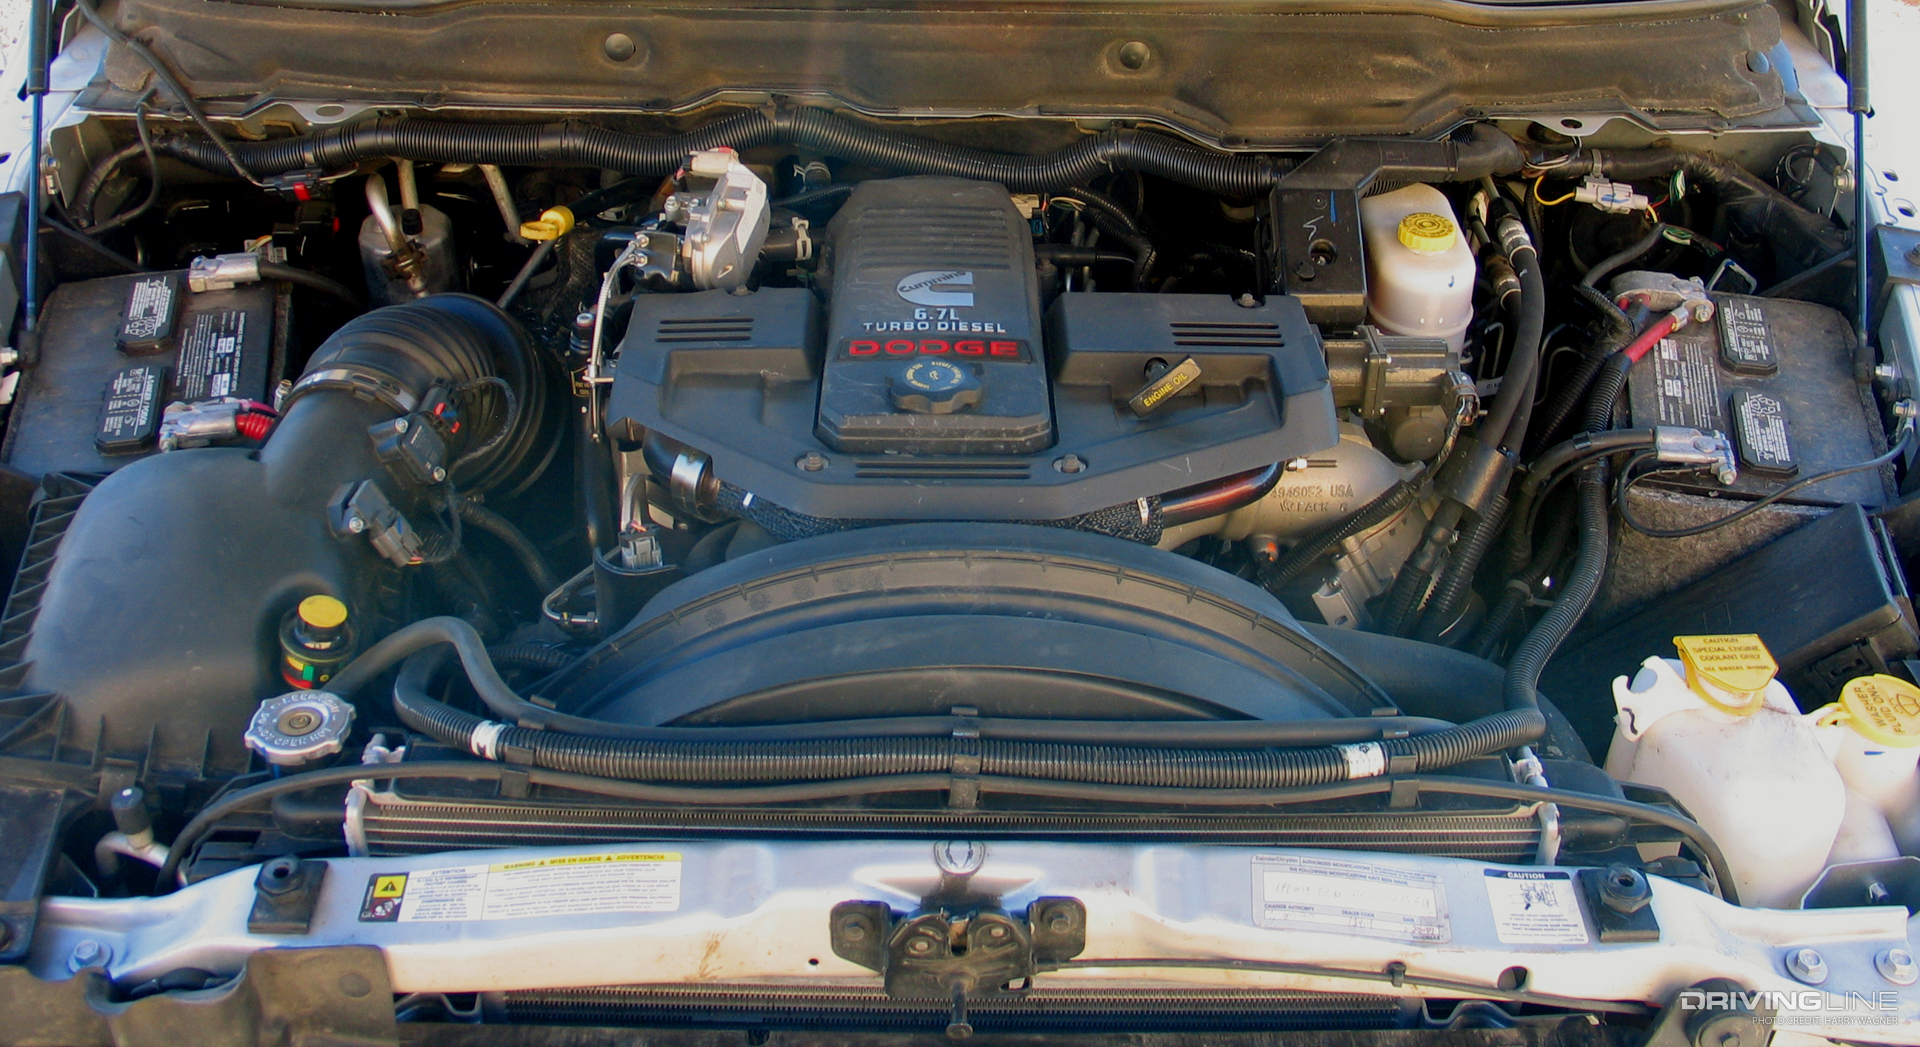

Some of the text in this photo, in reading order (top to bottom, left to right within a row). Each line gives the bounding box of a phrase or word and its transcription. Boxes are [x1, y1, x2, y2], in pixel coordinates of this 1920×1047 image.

[914, 308, 959, 321] 6.7L
[862, 321, 1007, 334] TURBO DIESEL
[849, 339, 1019, 356] DODGE
[1142, 372, 1189, 408] ENGINE OIL
[1330, 484, 1355, 498] USA
[1702, 637, 1739, 645] CAUTION
[1699, 654, 1739, 662] COOLANT
[1853, 686, 1888, 728] WASHER
[1860, 679, 1907, 734] FLUID ONLY
[503, 861, 536, 869] WARNING
[549, 857, 567, 865] MISE
[578, 856, 602, 864] GARDE
[1255, 855, 1299, 864] DaimlerChrysler
[1302, 859, 1371, 871] AUTHORIZED MODIFICATIONS
[1507, 871, 1546, 880] CAUTION
[1287, 904, 1315, 912] AUTHORITY
